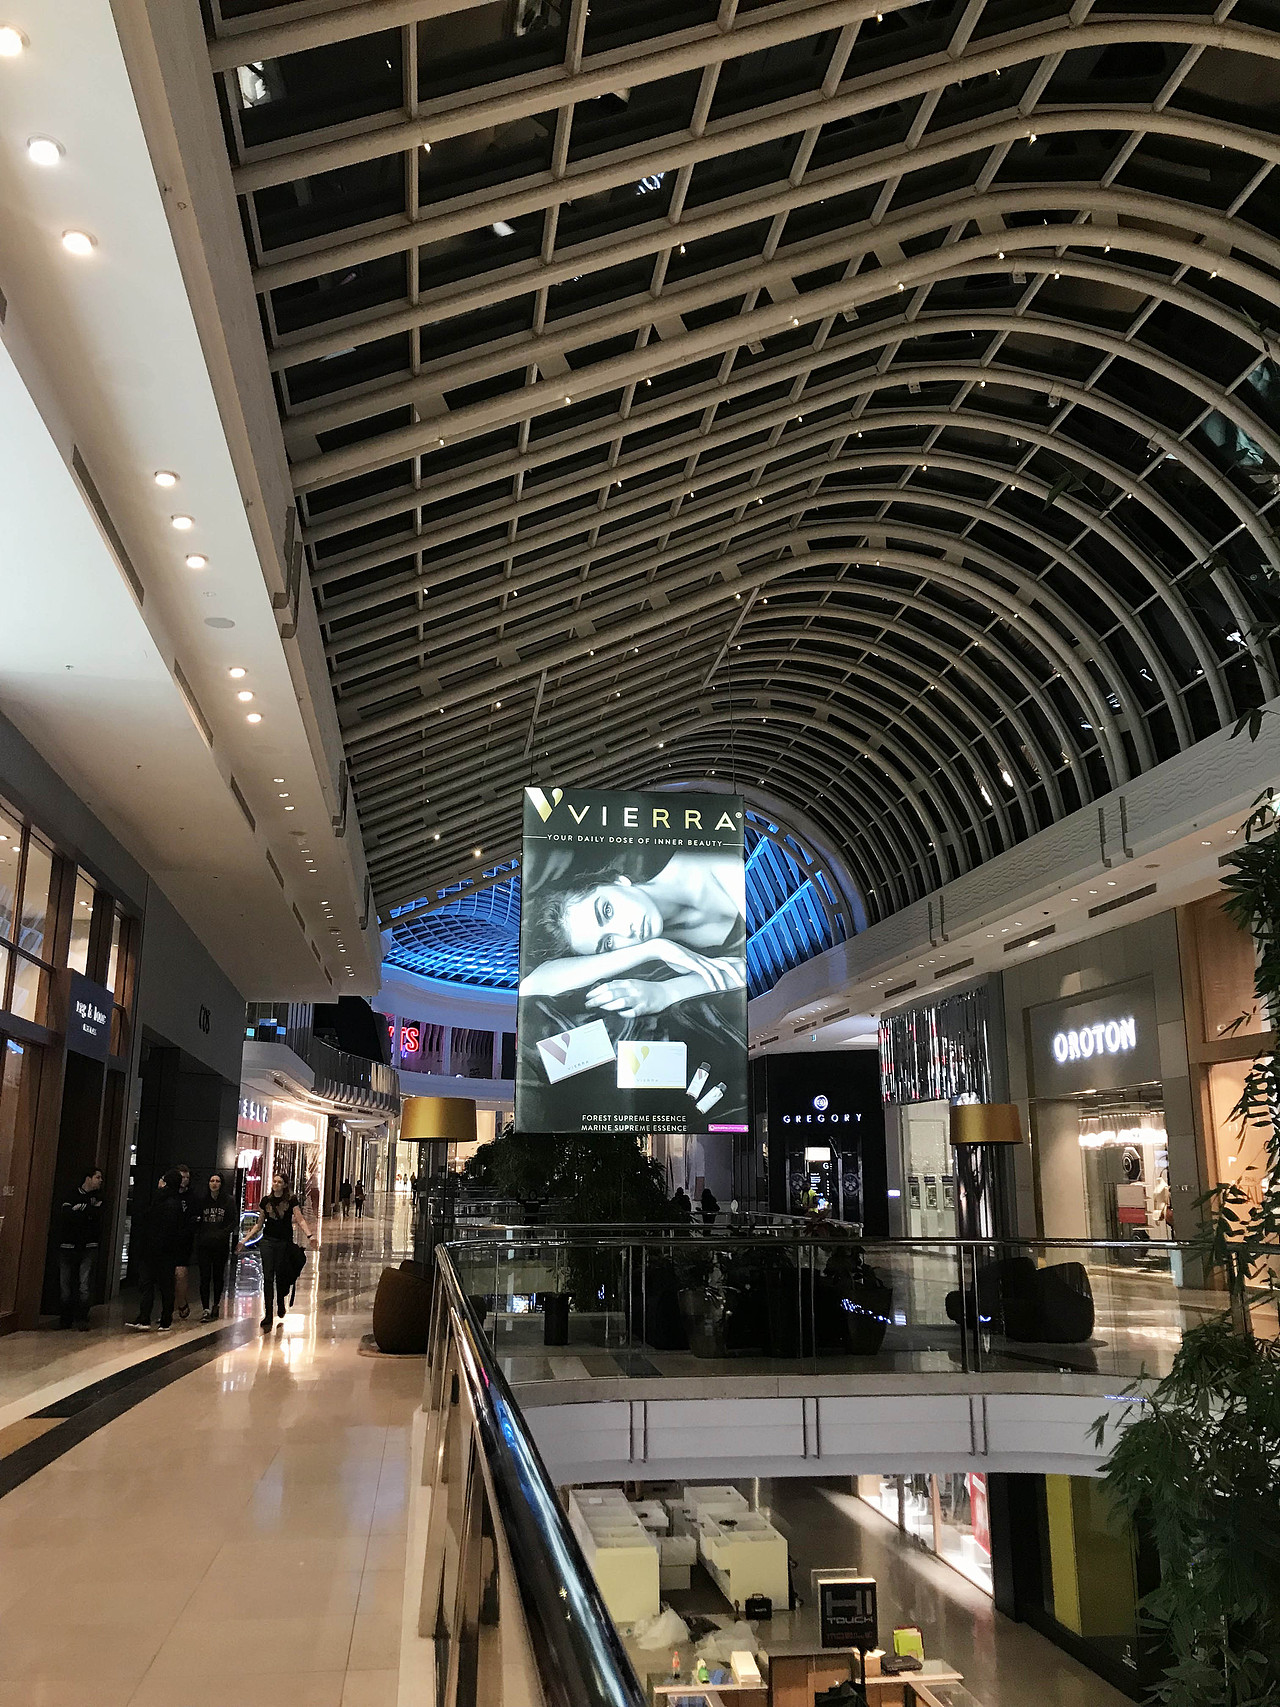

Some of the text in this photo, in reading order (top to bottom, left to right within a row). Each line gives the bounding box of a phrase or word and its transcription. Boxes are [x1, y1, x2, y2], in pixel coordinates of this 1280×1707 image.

[547, 834, 573, 842] YOUR
[577, 835, 605, 843] DAILY
[609, 836, 634, 844] DOSE
[654, 838, 684, 846] INNER
[687, 839, 723, 847] BEAUTY
[1053, 1016, 1137, 1063] OROTON
[582, 1114, 612, 1122] FOREST
[613, 1114, 651, 1122] SUPREME
[782, 1113, 862, 1124] GREGORY
[581, 1124, 612, 1132] MARINE
[614, 1124, 651, 1132] SUPREME
[825, 1589, 873, 1617] HI
[826, 1616, 874, 1625] TOUCH
